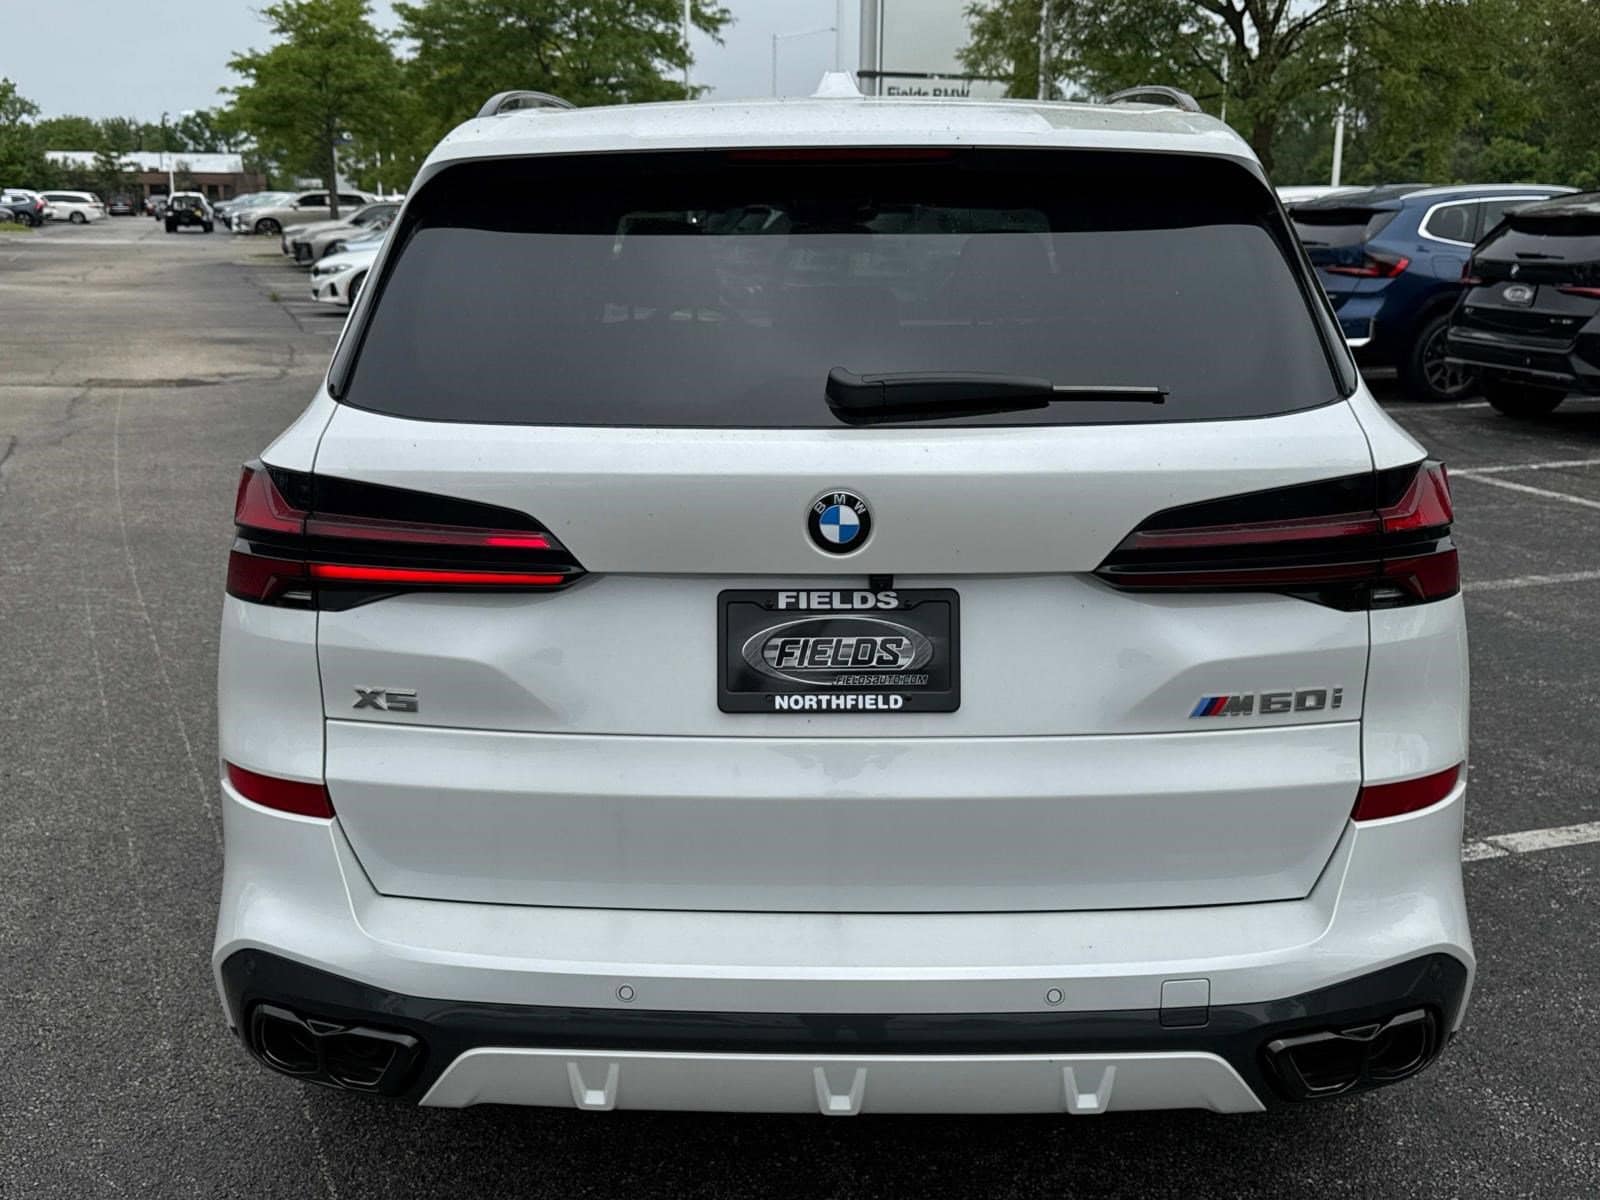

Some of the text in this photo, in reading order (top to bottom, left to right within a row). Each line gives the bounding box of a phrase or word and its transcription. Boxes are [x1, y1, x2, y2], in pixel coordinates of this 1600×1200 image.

[813, 493, 866, 514] BMW
[778, 591, 899, 609] FIELDS
[774, 637, 905, 669] FIELDS
[352, 687, 419, 712] X5
[774, 694, 903, 710] NORTHFIELD
